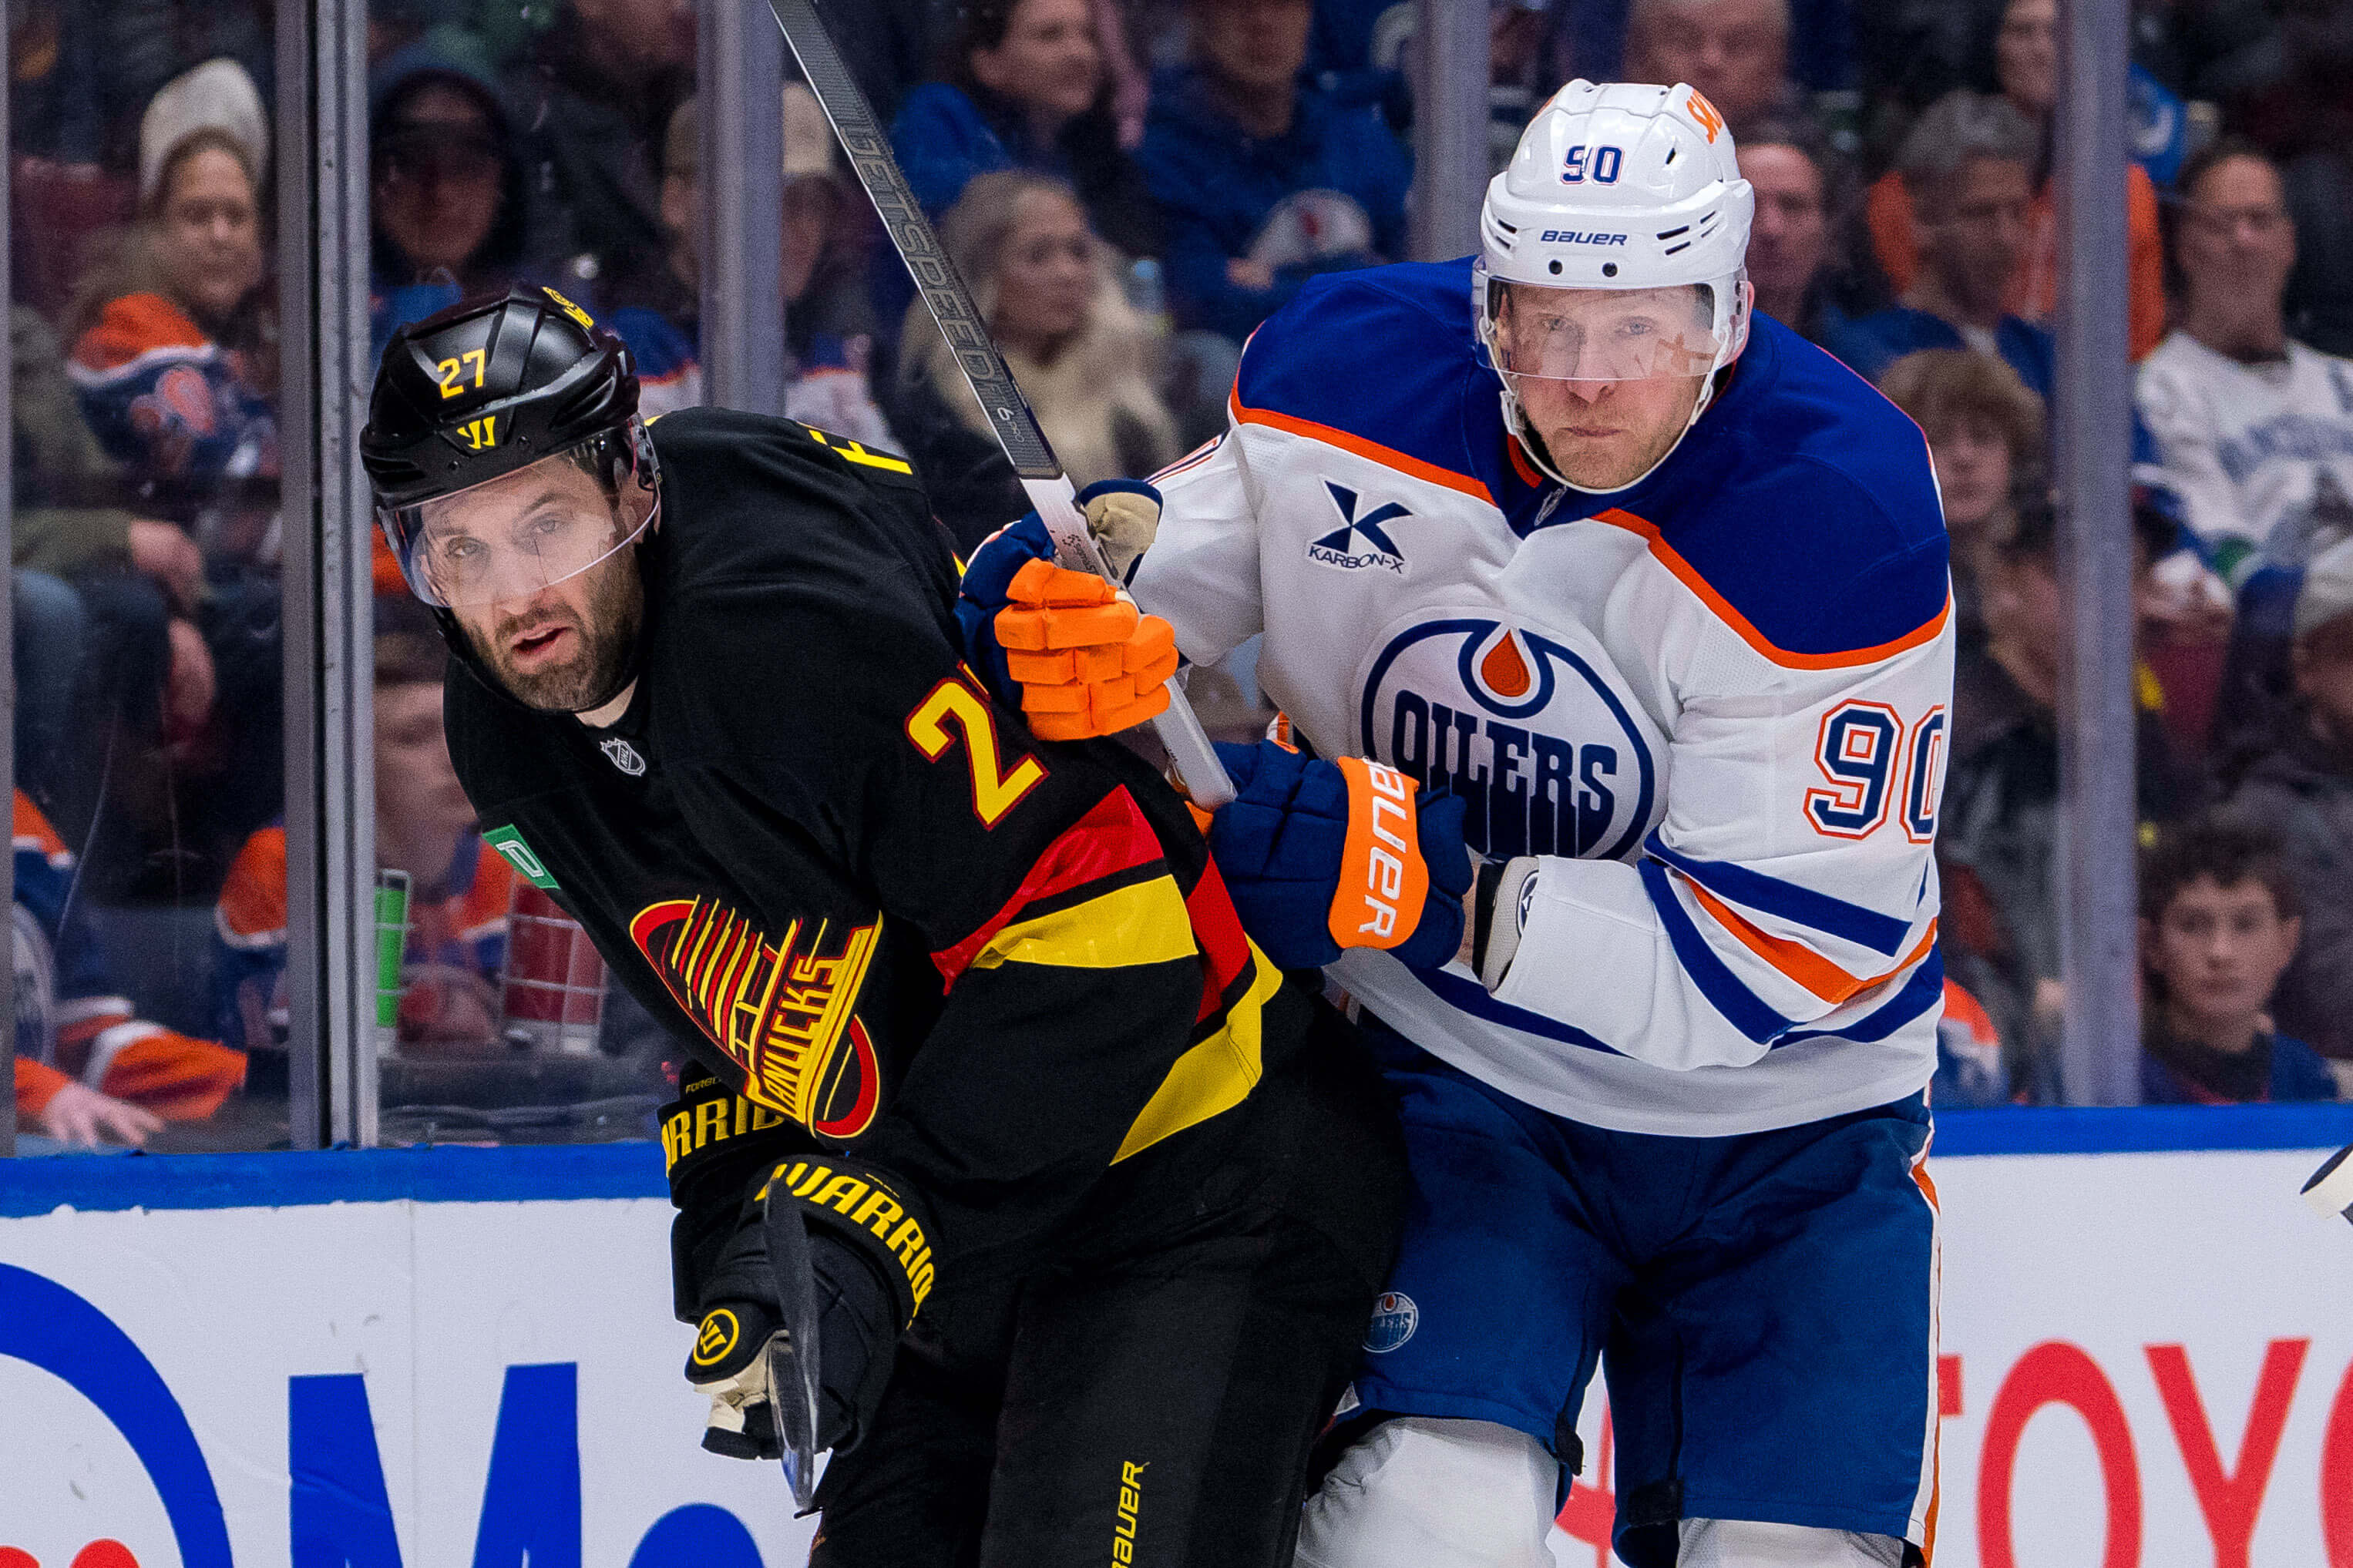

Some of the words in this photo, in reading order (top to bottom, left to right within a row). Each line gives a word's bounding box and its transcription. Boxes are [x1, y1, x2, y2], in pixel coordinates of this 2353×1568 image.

[1540, 230, 1628, 247] BAUER
[1560, 144, 1625, 186] 90
[840, 126, 995, 379] JETSPEED
[437, 348, 486, 399] 27
[1308, 545, 1405, 575] KARBON-X
[903, 660, 1051, 832] 2
[1392, 689, 1618, 858] OILERS
[1358, 755, 1407, 938] AUER
[754, 1162, 935, 1331] WARRIO
[1937, 1337, 2353, 1568] OY
